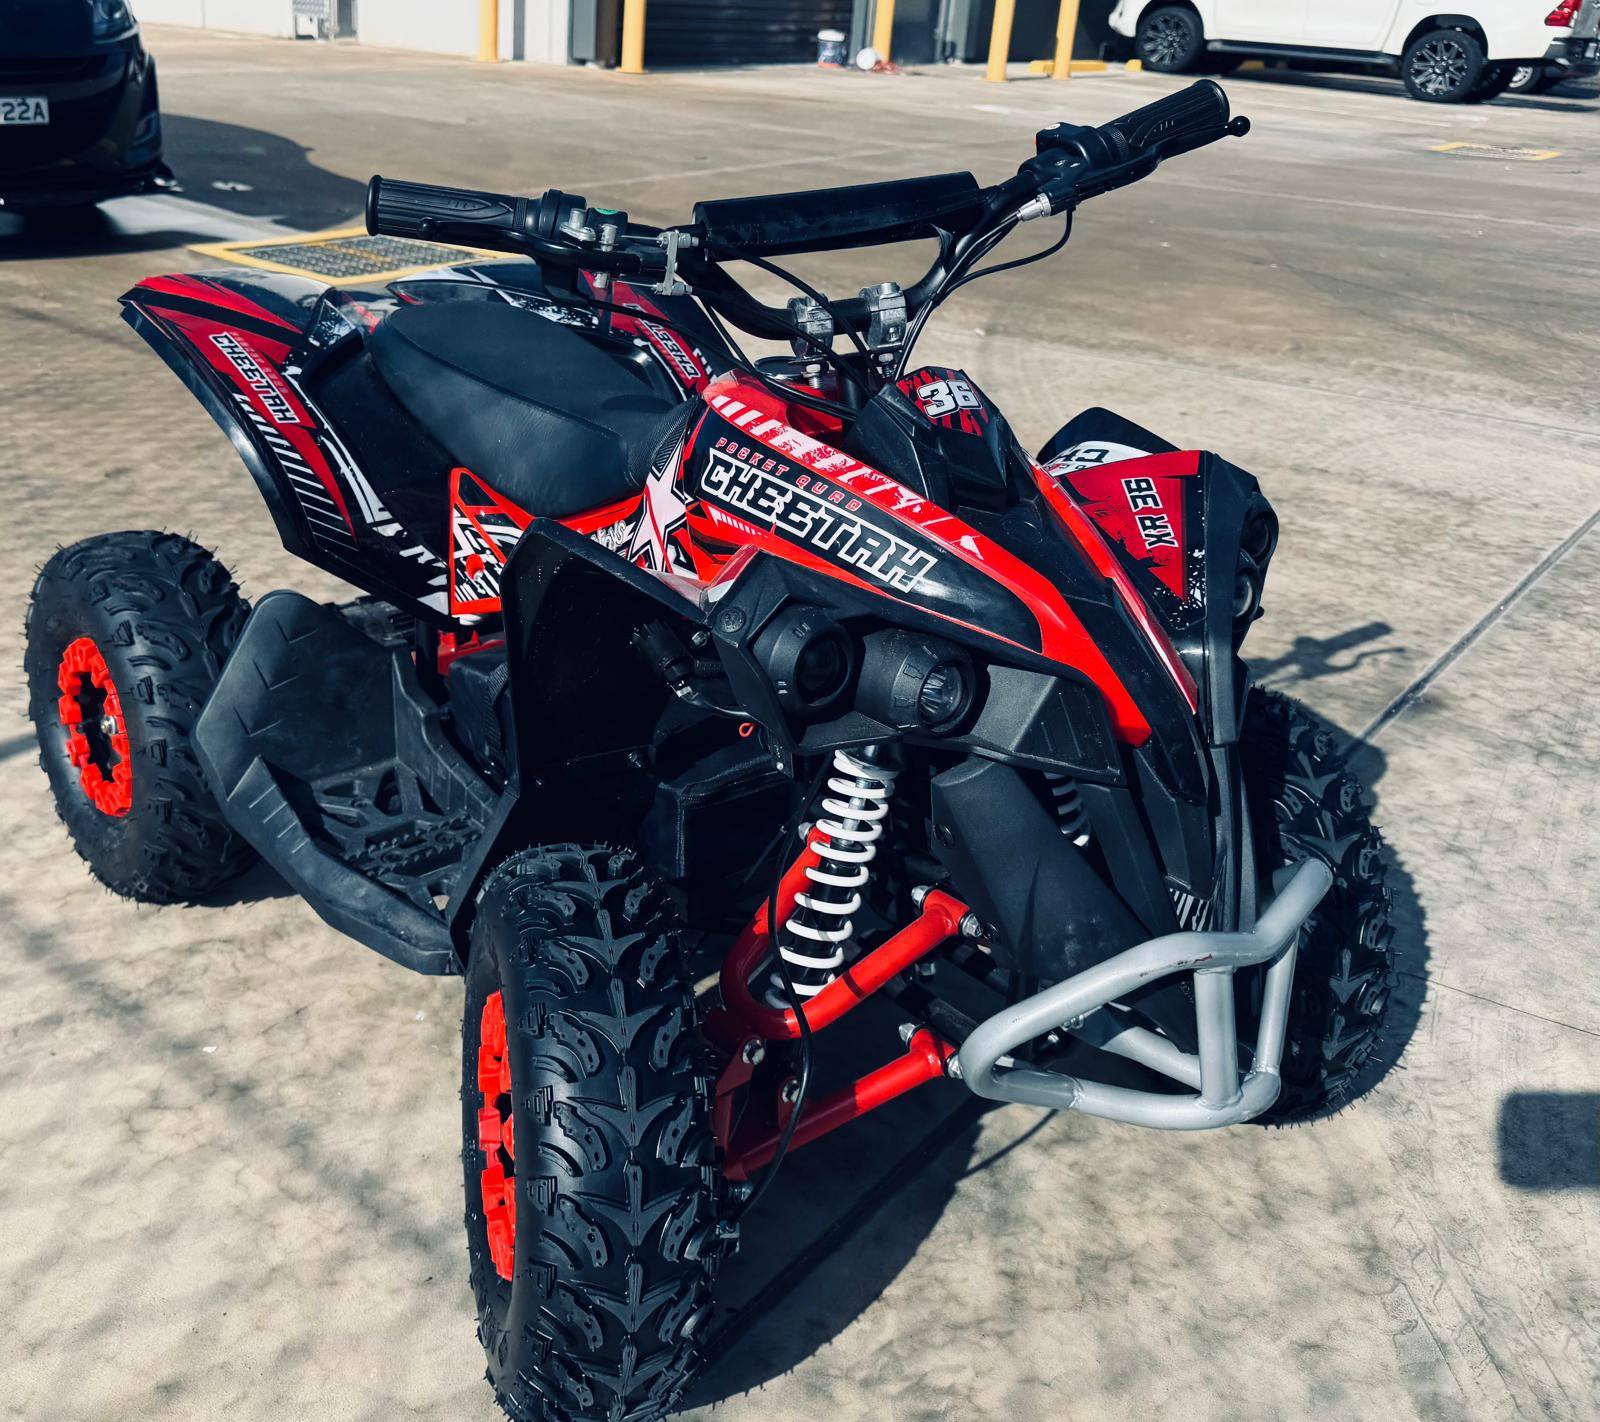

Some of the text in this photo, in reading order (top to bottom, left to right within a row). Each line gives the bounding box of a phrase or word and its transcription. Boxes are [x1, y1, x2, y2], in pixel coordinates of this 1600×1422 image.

[2, 101, 46, 121] 22A
[209, 331, 300, 423] CHEETAH
[917, 379, 982, 418] 36
[716, 437, 863, 512] POCKET QUAD
[701, 447, 939, 593] CHEETAH
[1121, 477, 1179, 549] XR 36
